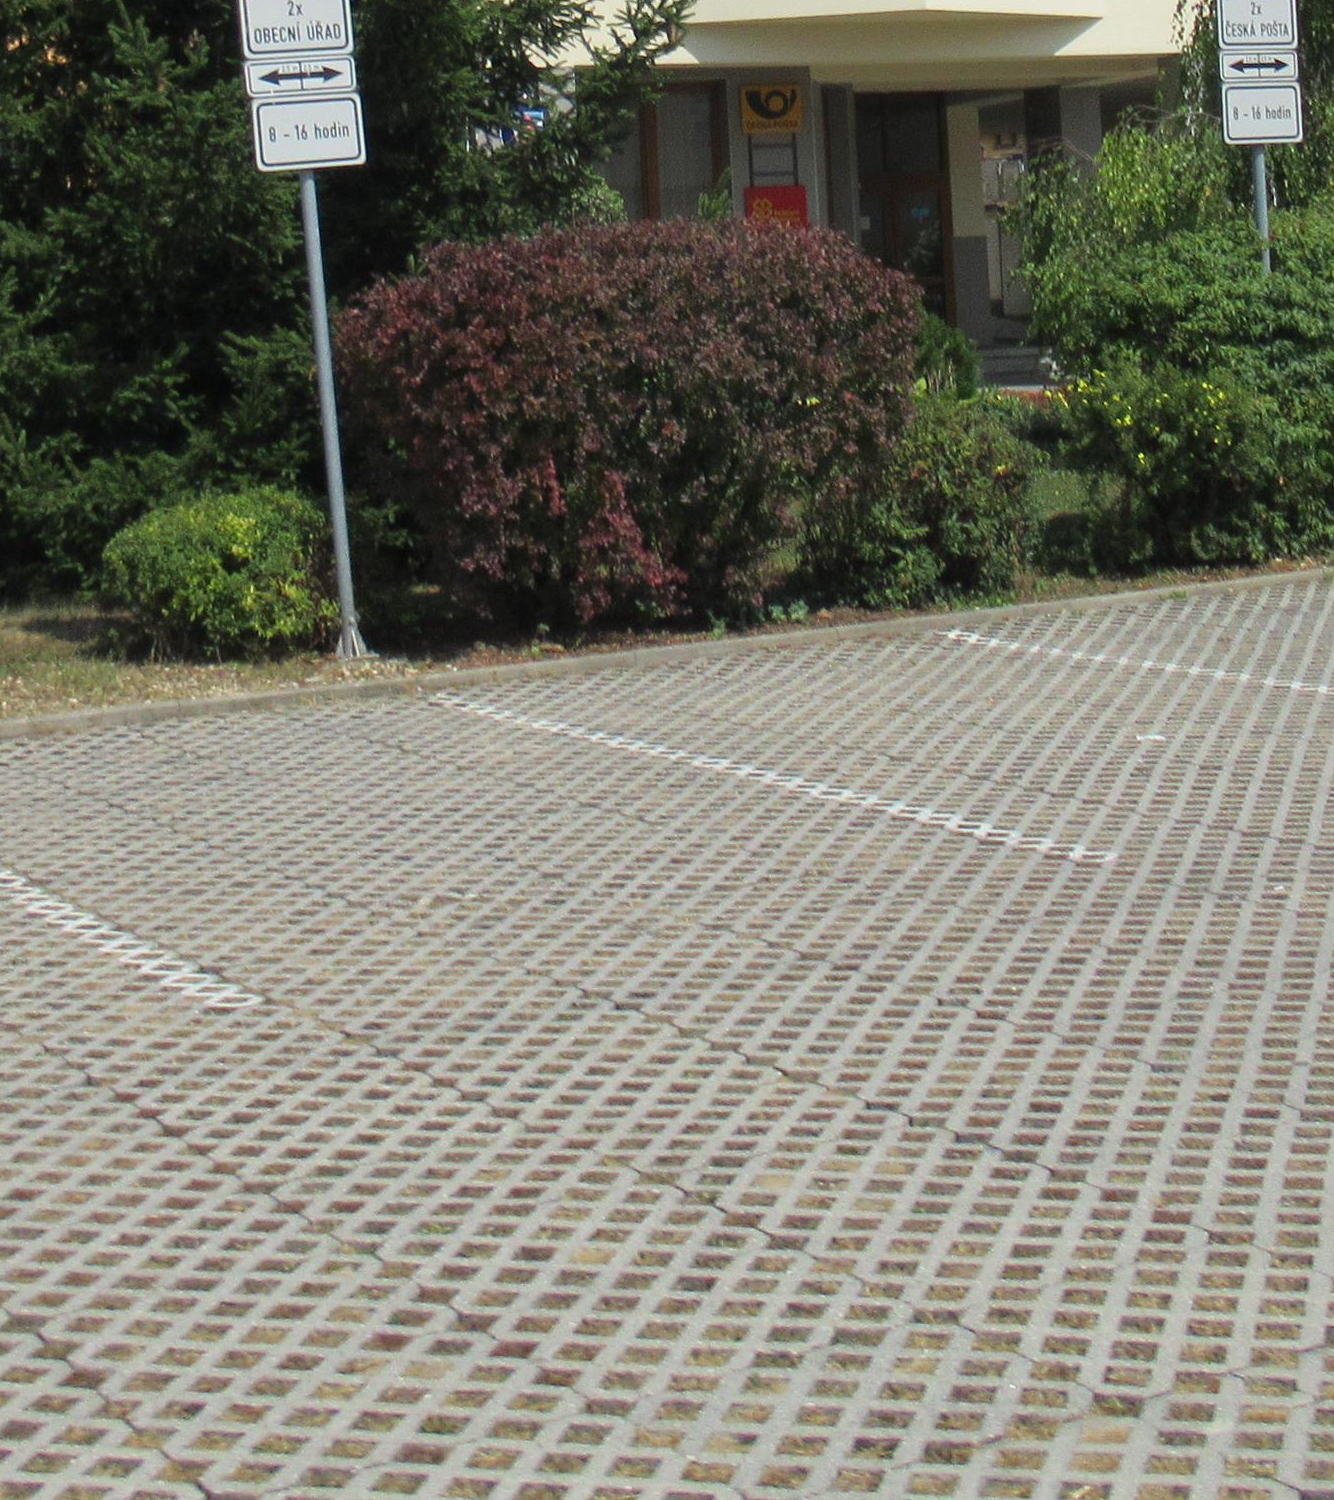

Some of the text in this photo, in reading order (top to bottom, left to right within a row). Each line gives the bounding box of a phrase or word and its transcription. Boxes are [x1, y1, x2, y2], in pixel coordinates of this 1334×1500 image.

[287, 0, 303, 17] 2x
[253, 18, 342, 44] OBECNÍ ÚŘAD
[1225, 18, 1290, 38] ČESKÁ POŠTA
[268, 126, 277, 142] 8
[295, 124, 308, 141] 16
[314, 122, 350, 140] hodin
